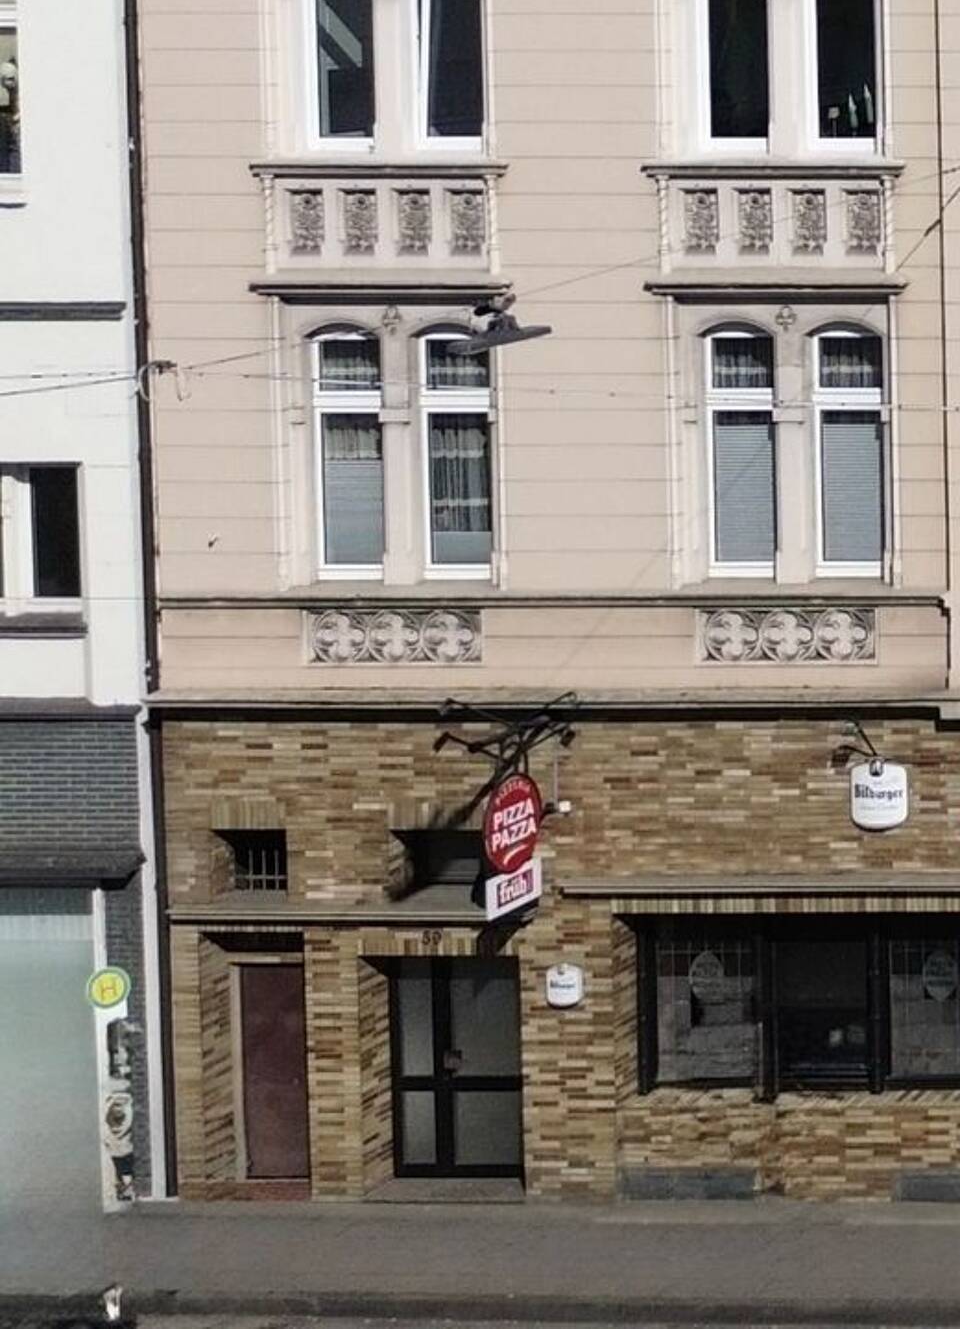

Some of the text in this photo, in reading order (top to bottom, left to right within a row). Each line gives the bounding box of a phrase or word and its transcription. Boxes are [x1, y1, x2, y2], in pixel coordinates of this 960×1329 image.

[493, 797, 534, 831] PIZZA
[492, 817, 537, 853] PAZZA
[100, 976, 118, 1001] H
